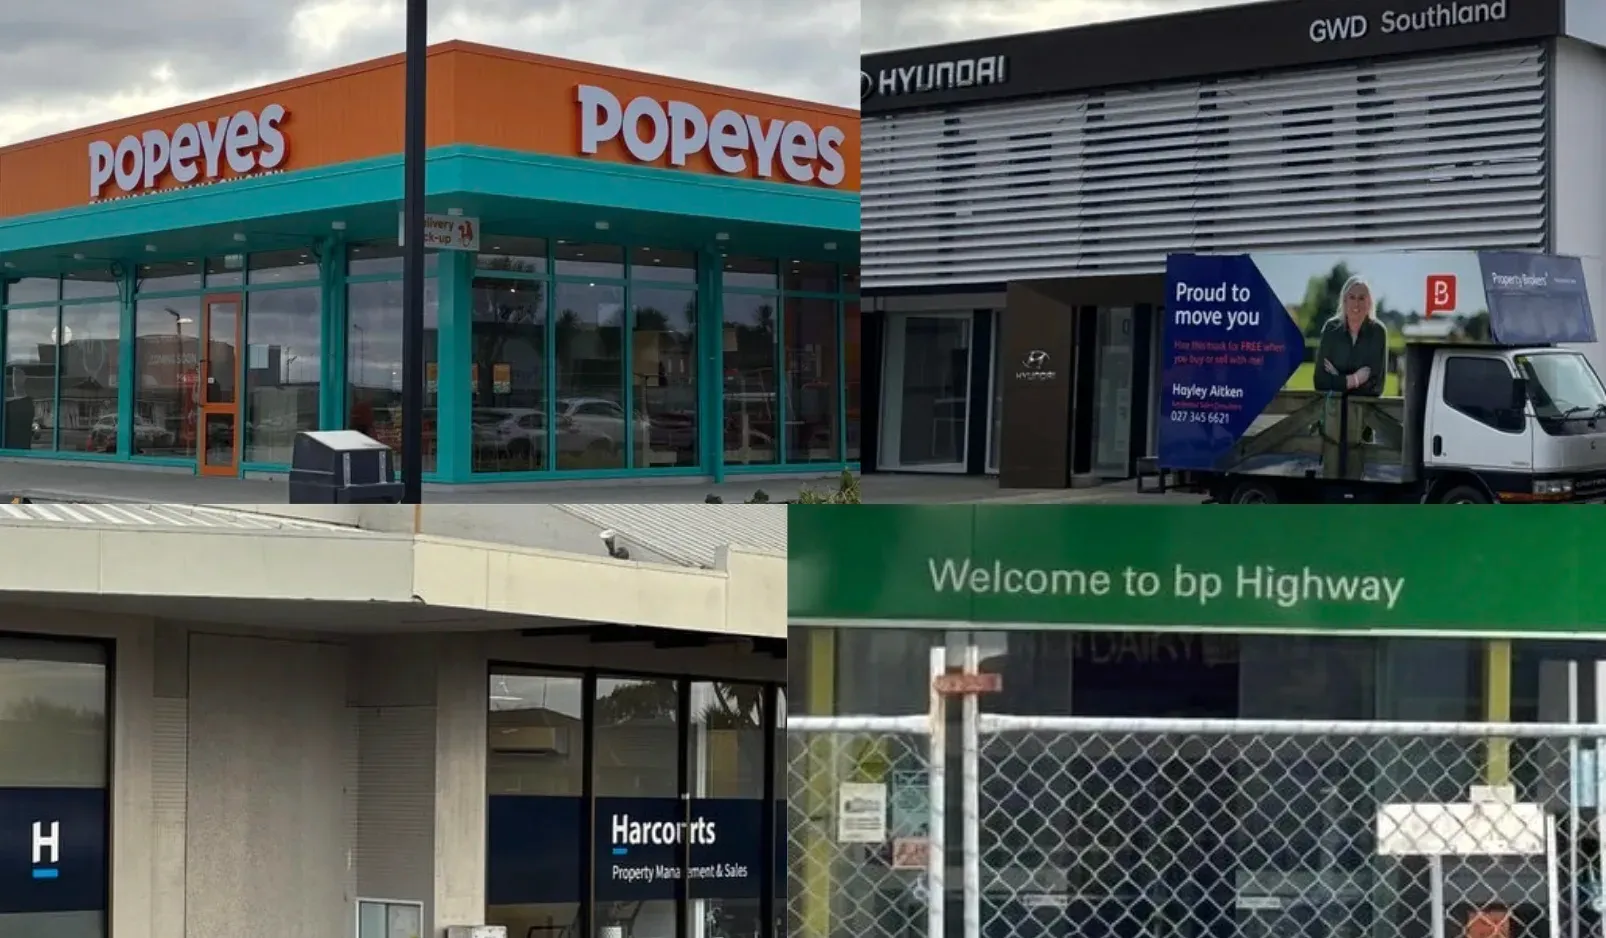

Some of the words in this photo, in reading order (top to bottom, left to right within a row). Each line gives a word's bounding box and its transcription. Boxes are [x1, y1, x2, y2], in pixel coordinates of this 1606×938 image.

[1309, 15, 1368, 43] GWD
[1380, 0, 1507, 34] Southland
[878, 55, 1005, 95] HYUNDAI
[577, 84, 847, 187] POPEYES
[88, 103, 287, 197] POPEYES
[1175, 281, 1227, 303] Proud
[1231, 283, 1251, 303] to
[1174, 309, 1223, 326] move
[1226, 310, 1260, 331] you
[1240, 341, 1262, 352] FREE
[1189, 355, 1204, 367] buy
[1172, 383, 1208, 400] Hayley
[1209, 383, 1244, 398] Aitken
[1171, 411, 1188, 422] 027
[1190, 411, 1206, 423] 345
[1207, 412, 1230, 424] 6621
[929, 557, 1111, 596] Welcome
[1123, 565, 1161, 597] to
[1173, 563, 1223, 606] bp
[1236, 565, 1405, 610] Highway
[32, 820, 60, 864] H
[612, 865, 655, 883] Property
[655, 865, 715, 880] Manaement
[716, 863, 724, 877] &
[725, 862, 748, 877] Sales
